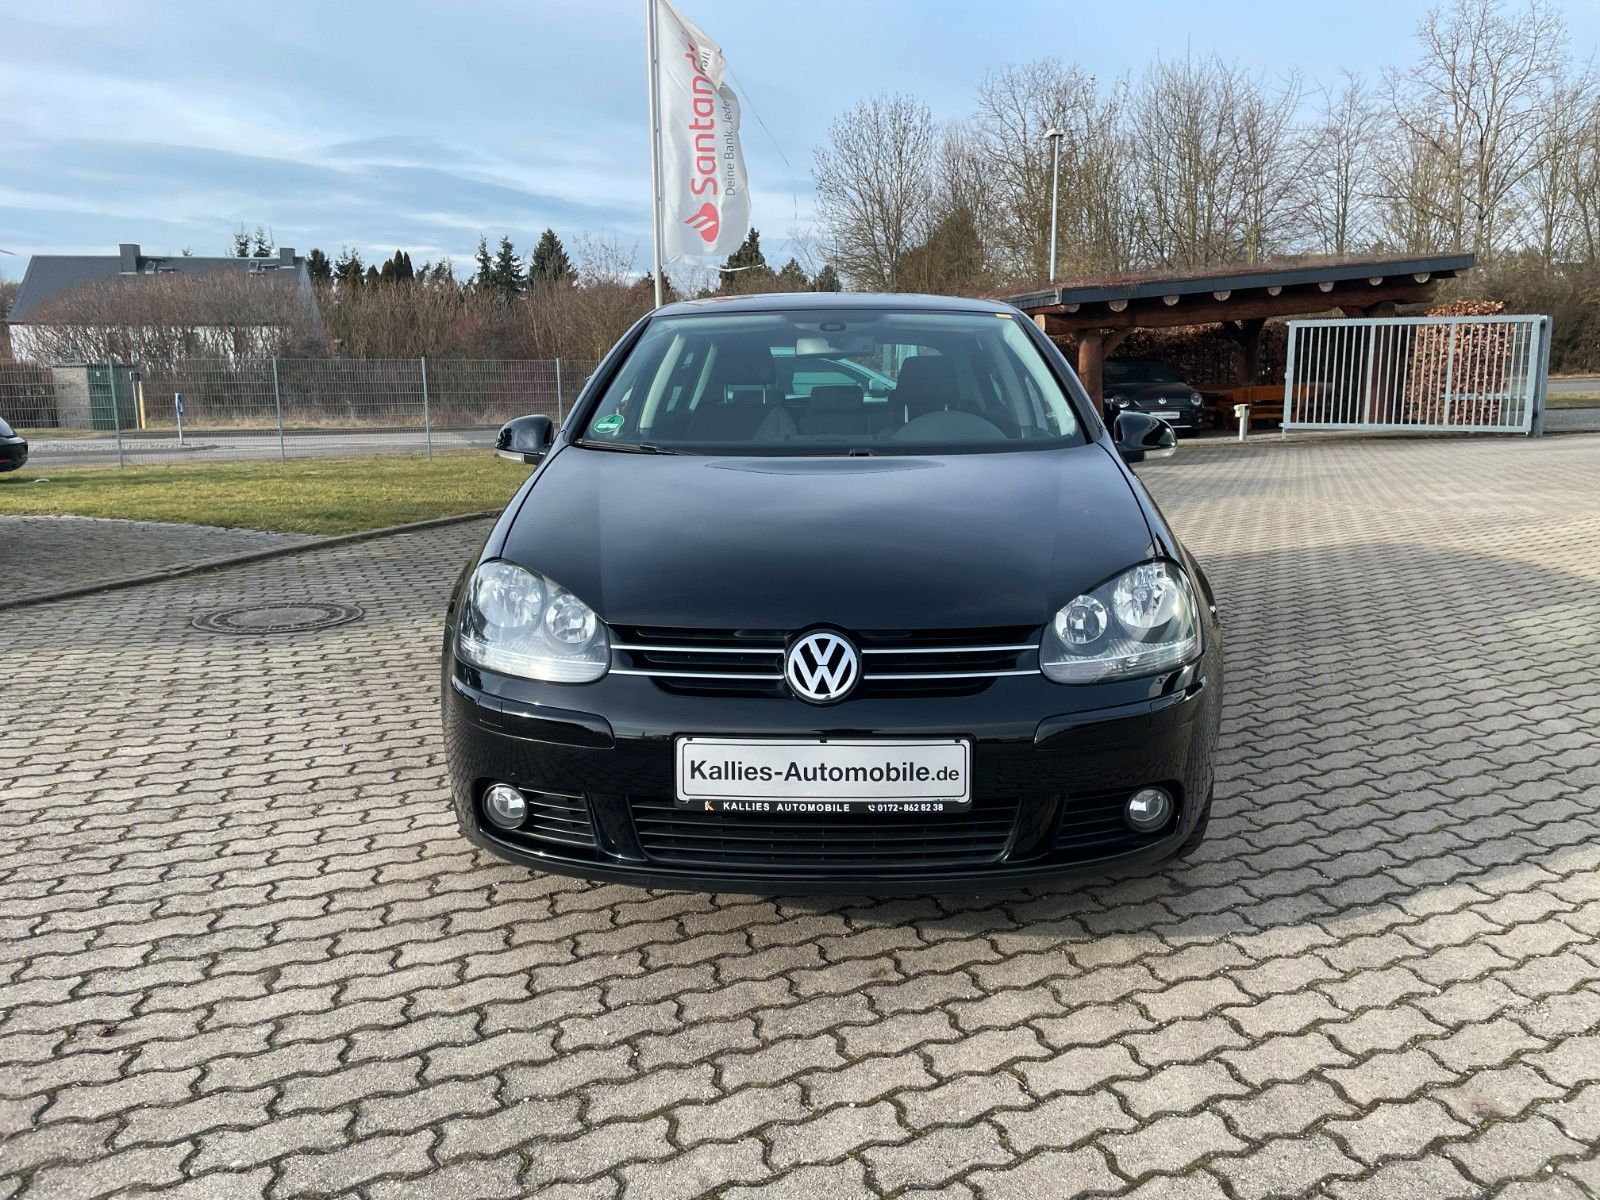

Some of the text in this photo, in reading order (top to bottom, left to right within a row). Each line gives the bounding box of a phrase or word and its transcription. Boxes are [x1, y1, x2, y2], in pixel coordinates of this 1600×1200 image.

[724, 128, 735, 160] Bank.
[725, 163, 736, 196] Deine
[788, 633, 858, 700] VW
[690, 760, 960, 782] Kallies-Automobile.de
[723, 802, 770, 811] KALLIES
[776, 803, 850, 812] AUTOMOBILE
